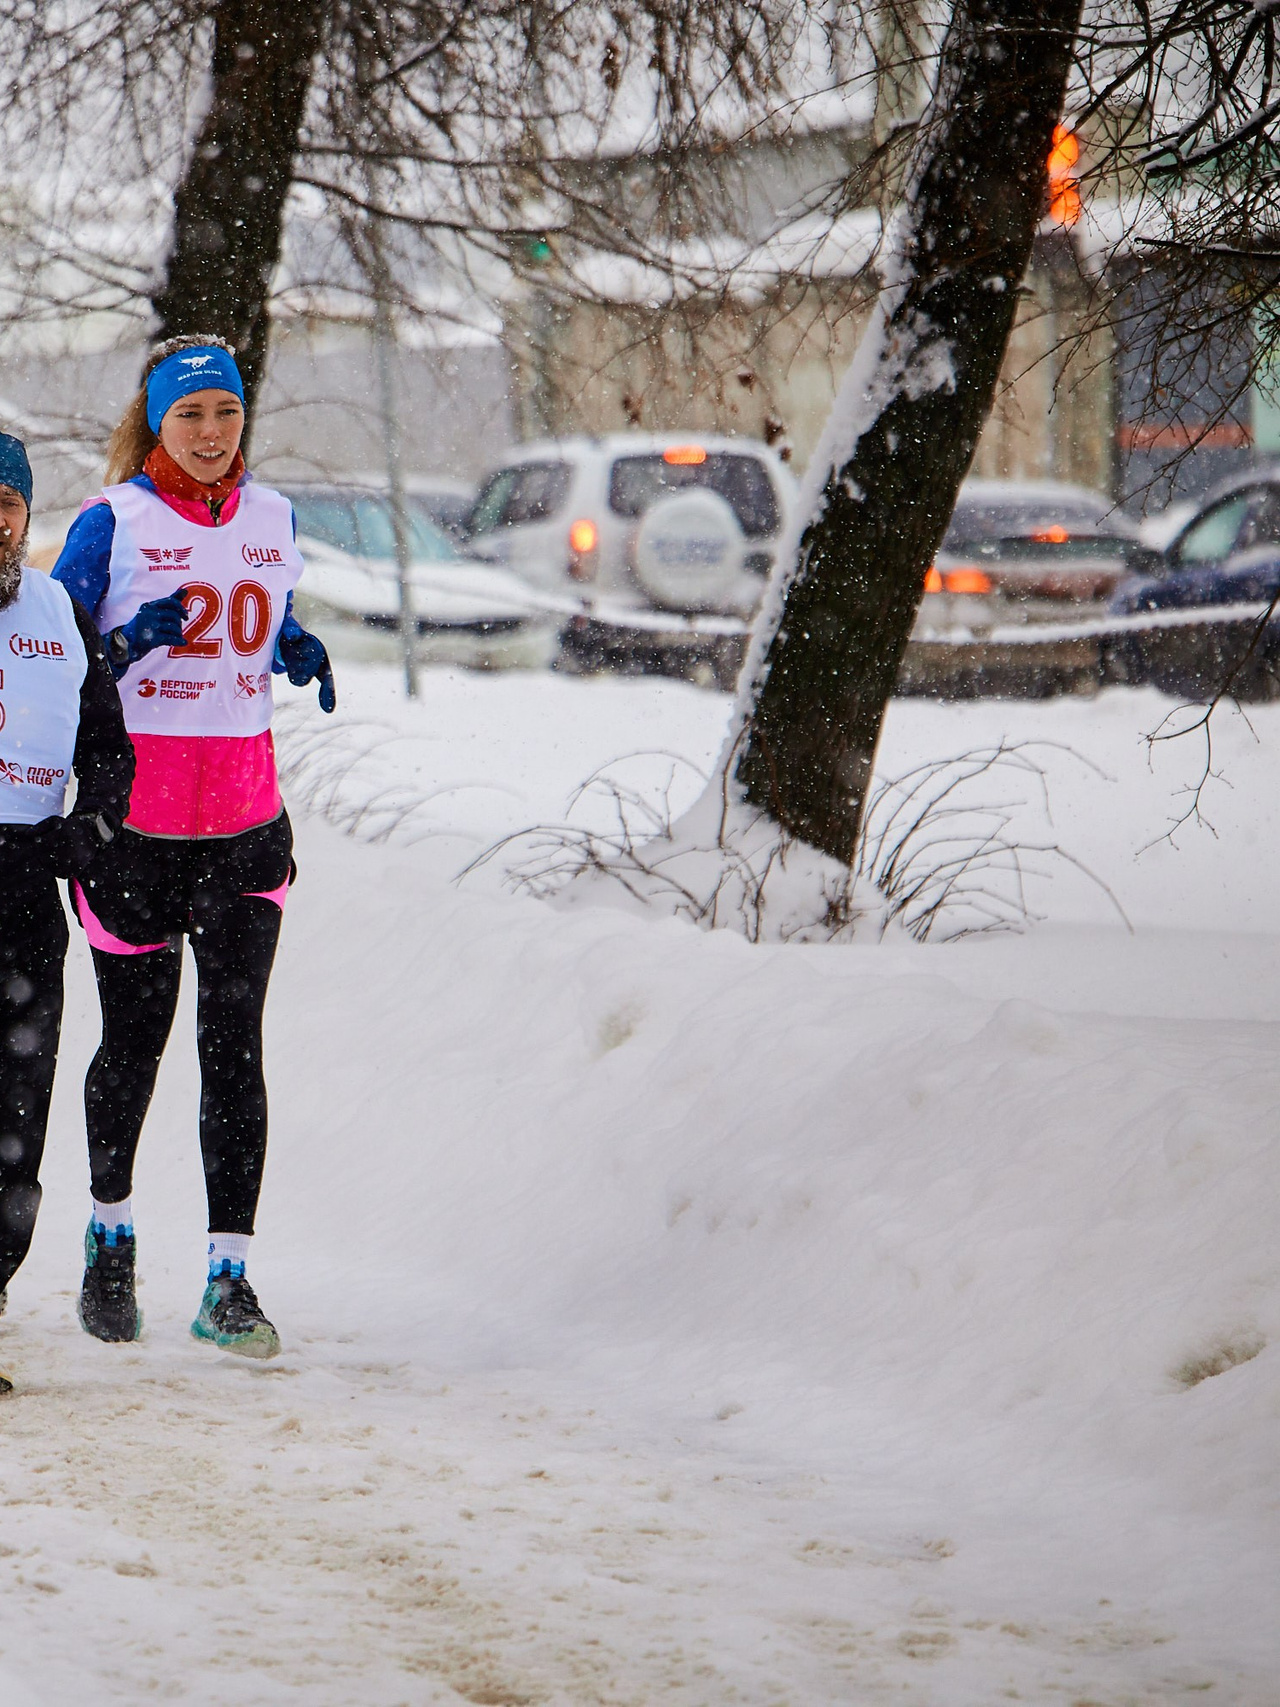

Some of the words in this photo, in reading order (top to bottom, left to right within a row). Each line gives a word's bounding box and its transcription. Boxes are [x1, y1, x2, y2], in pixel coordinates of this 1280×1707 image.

[177, 373, 191, 381] MAD
[246, 548, 283, 562] НЦВ
[167, 579, 272, 659] 20
[18, 637, 64, 656] НЦВ
[160, 679, 217, 691] ВЕРТОЛЕТЫ
[160, 689, 200, 700] РОССИИ
[27, 766, 65, 778] ППОО
[26, 775, 53, 787] НЦВ
